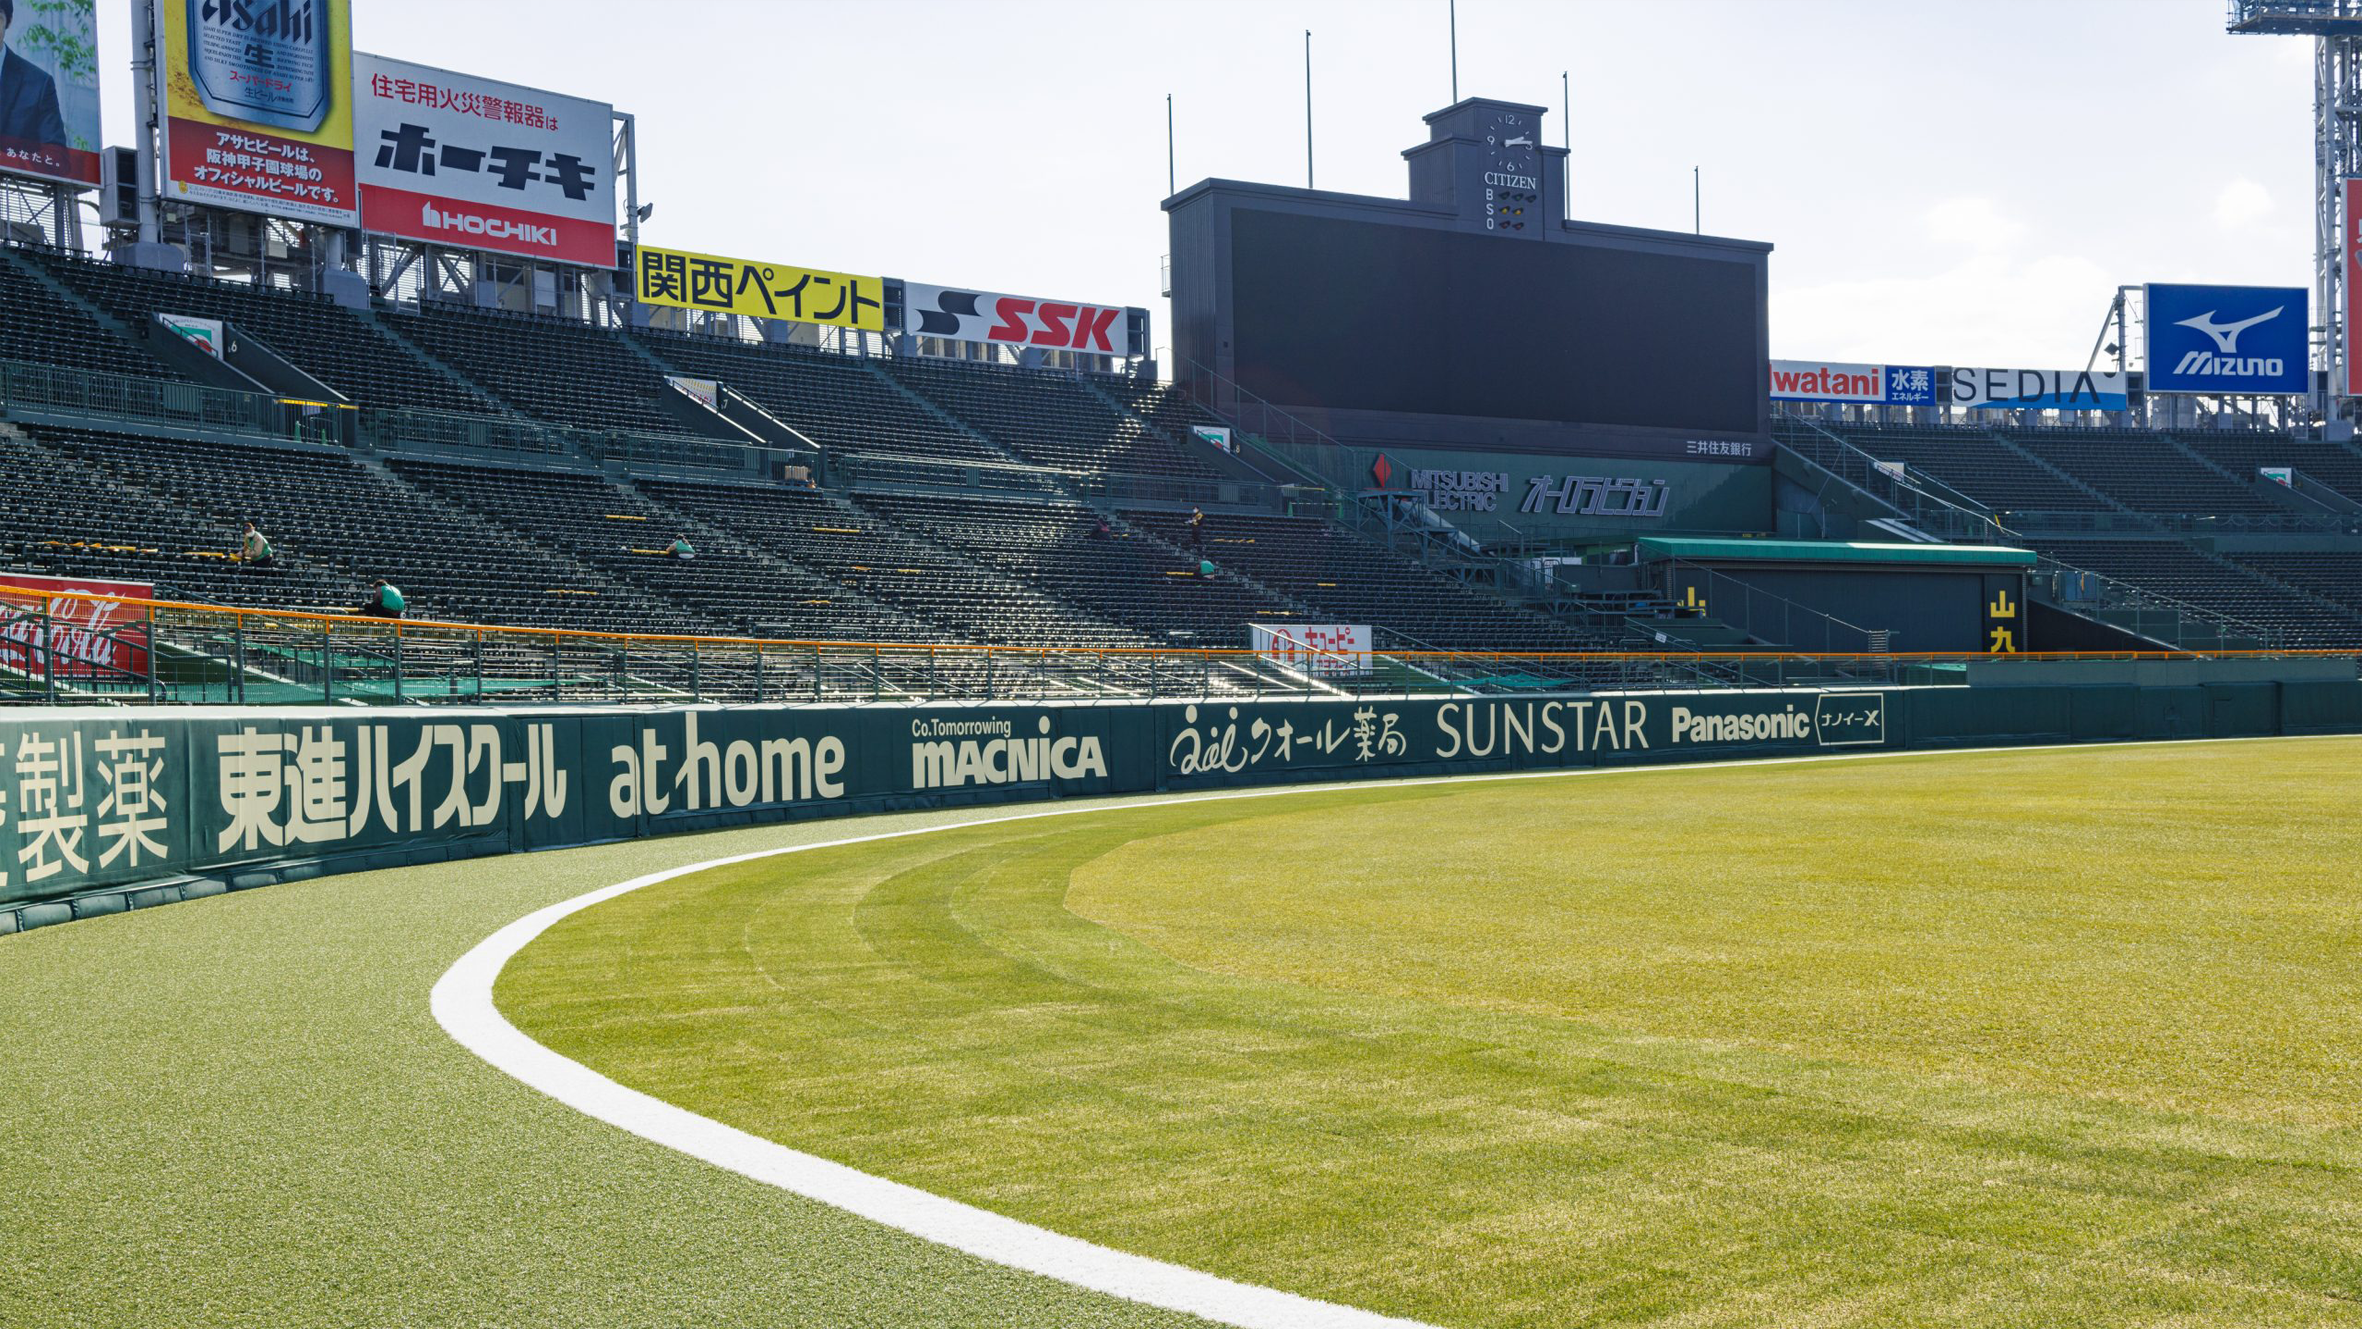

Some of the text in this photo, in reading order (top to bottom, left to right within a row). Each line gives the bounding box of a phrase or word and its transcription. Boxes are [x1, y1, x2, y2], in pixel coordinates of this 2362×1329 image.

[244, 43, 275, 69] 生
[230, 70, 292, 92] スーパードライ
[371, 72, 559, 131] 住宅用火災警報器は
[1505, 114, 1515, 125] 12
[216, 131, 315, 163] アサヒビールは、
[1487, 135, 1495, 145] 9
[206, 148, 322, 182] 阪神甲子園球場の
[374, 122, 596, 201] ホーチキ
[1506, 161, 1515, 172] 6
[194, 165, 339, 203] オフィシャルビールです。
[1484, 171, 1537, 190] CITIZEN
[1486, 188, 1494, 200] B
[1486, 203, 1494, 215] S
[443, 212, 557, 246] HOCHIKI
[641, 250, 881, 325] 関西ペイント
[987, 296, 1120, 352] SSK
[1892, 369, 1929, 392] 水素
[1892, 392, 1929, 402] エネルギー
[1686, 440, 1752, 457] 三井住友銀行
[1411, 469, 1509, 493] MITSUBISHI
[1521, 474, 1670, 517] オーロラビジョン
[1415, 489, 1497, 511] LECTRIC
[1990, 590, 2015, 653] 山九
[912, 715, 1011, 738] Co.Tomorrowing
[1251, 706, 1407, 765] クオール薬局
[1436, 700, 1649, 759] SUNSTAR
[1672, 704, 1810, 744] Panasonic
[609, 711, 846, 818] at home
[218, 723, 567, 853] 東進ハイスクール
[0, 729, 168, 886] 製薬
